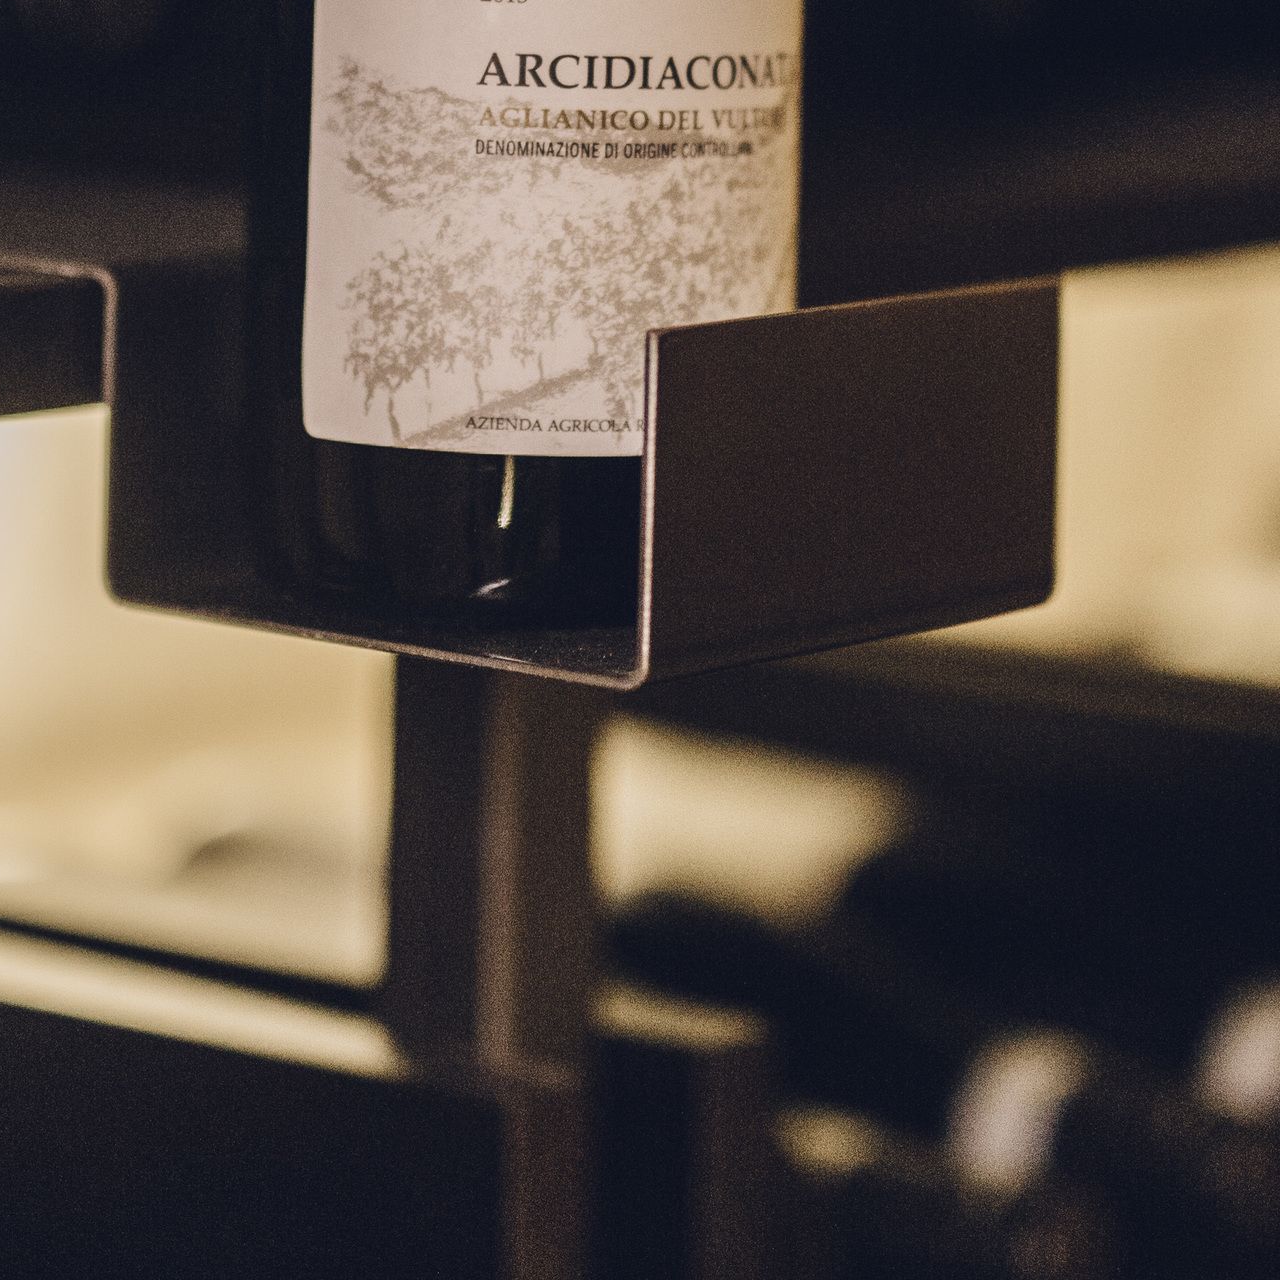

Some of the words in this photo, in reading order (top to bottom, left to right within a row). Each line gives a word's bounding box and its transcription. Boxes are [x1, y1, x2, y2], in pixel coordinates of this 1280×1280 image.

[479, 106, 650, 131] AGLIANICO
[658, 110, 704, 131] DEL
[475, 139, 600, 158] DENOMINAZIONE
[604, 143, 619, 158] DI
[623, 143, 678, 159] ORIGINE
[465, 416, 542, 433] AZIENDA
[548, 418, 631, 434] AGRICOLA
